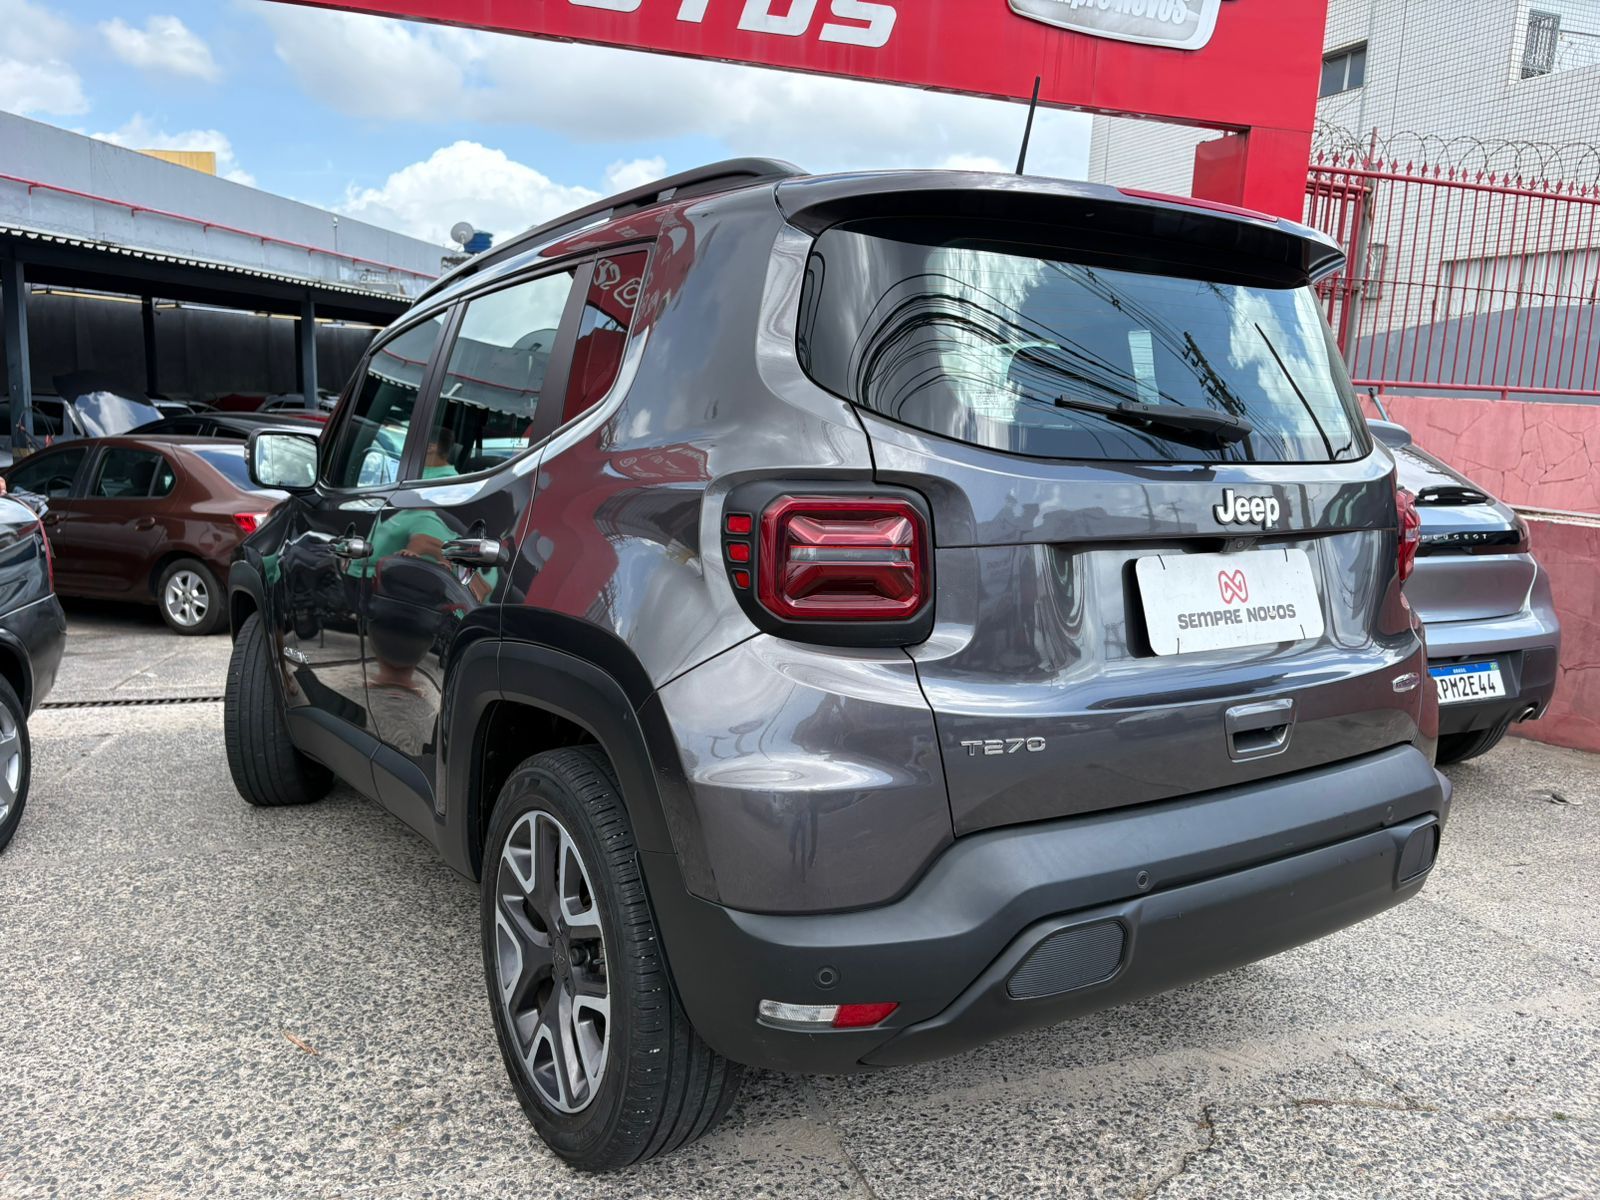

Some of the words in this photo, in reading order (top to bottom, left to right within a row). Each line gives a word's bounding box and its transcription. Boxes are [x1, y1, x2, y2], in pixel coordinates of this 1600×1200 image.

[1213, 488, 1280, 530] Jeep
[1177, 604, 1243, 630] SEMPRE
[1438, 673, 1497, 700] PM2E44
[961, 736, 1046, 756] T270
